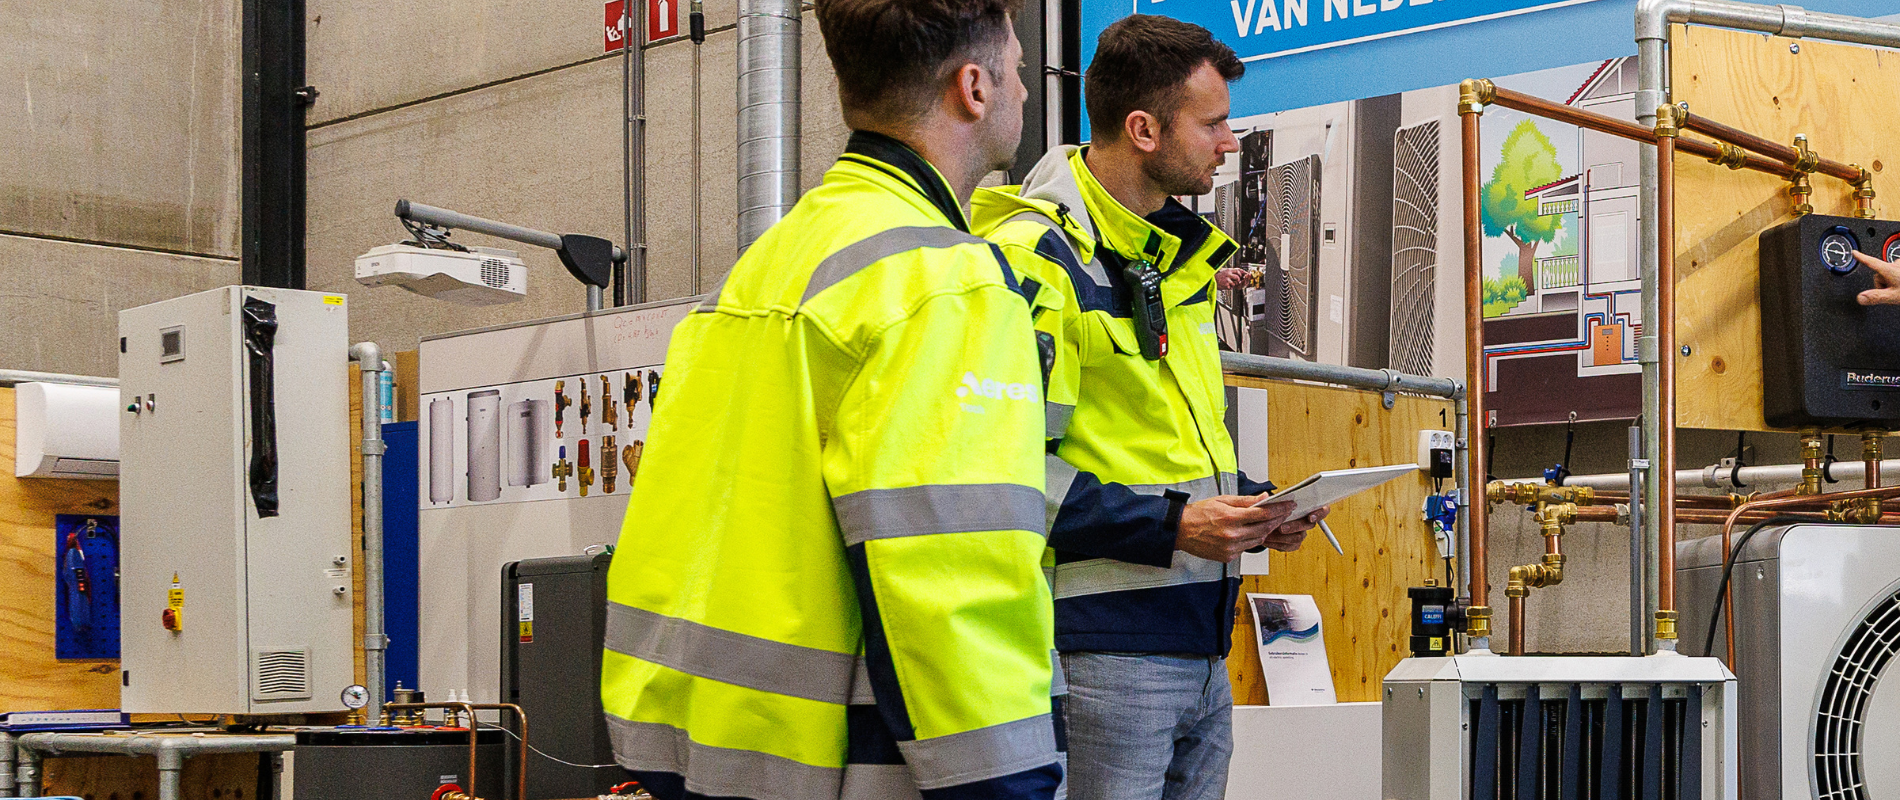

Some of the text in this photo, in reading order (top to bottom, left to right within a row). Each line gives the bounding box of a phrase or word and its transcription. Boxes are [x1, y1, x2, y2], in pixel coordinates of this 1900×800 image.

[1230, 0, 1309, 38] VAN
[956, 371, 1039, 403] Aeres
[1439, 408, 1446, 427] 1
